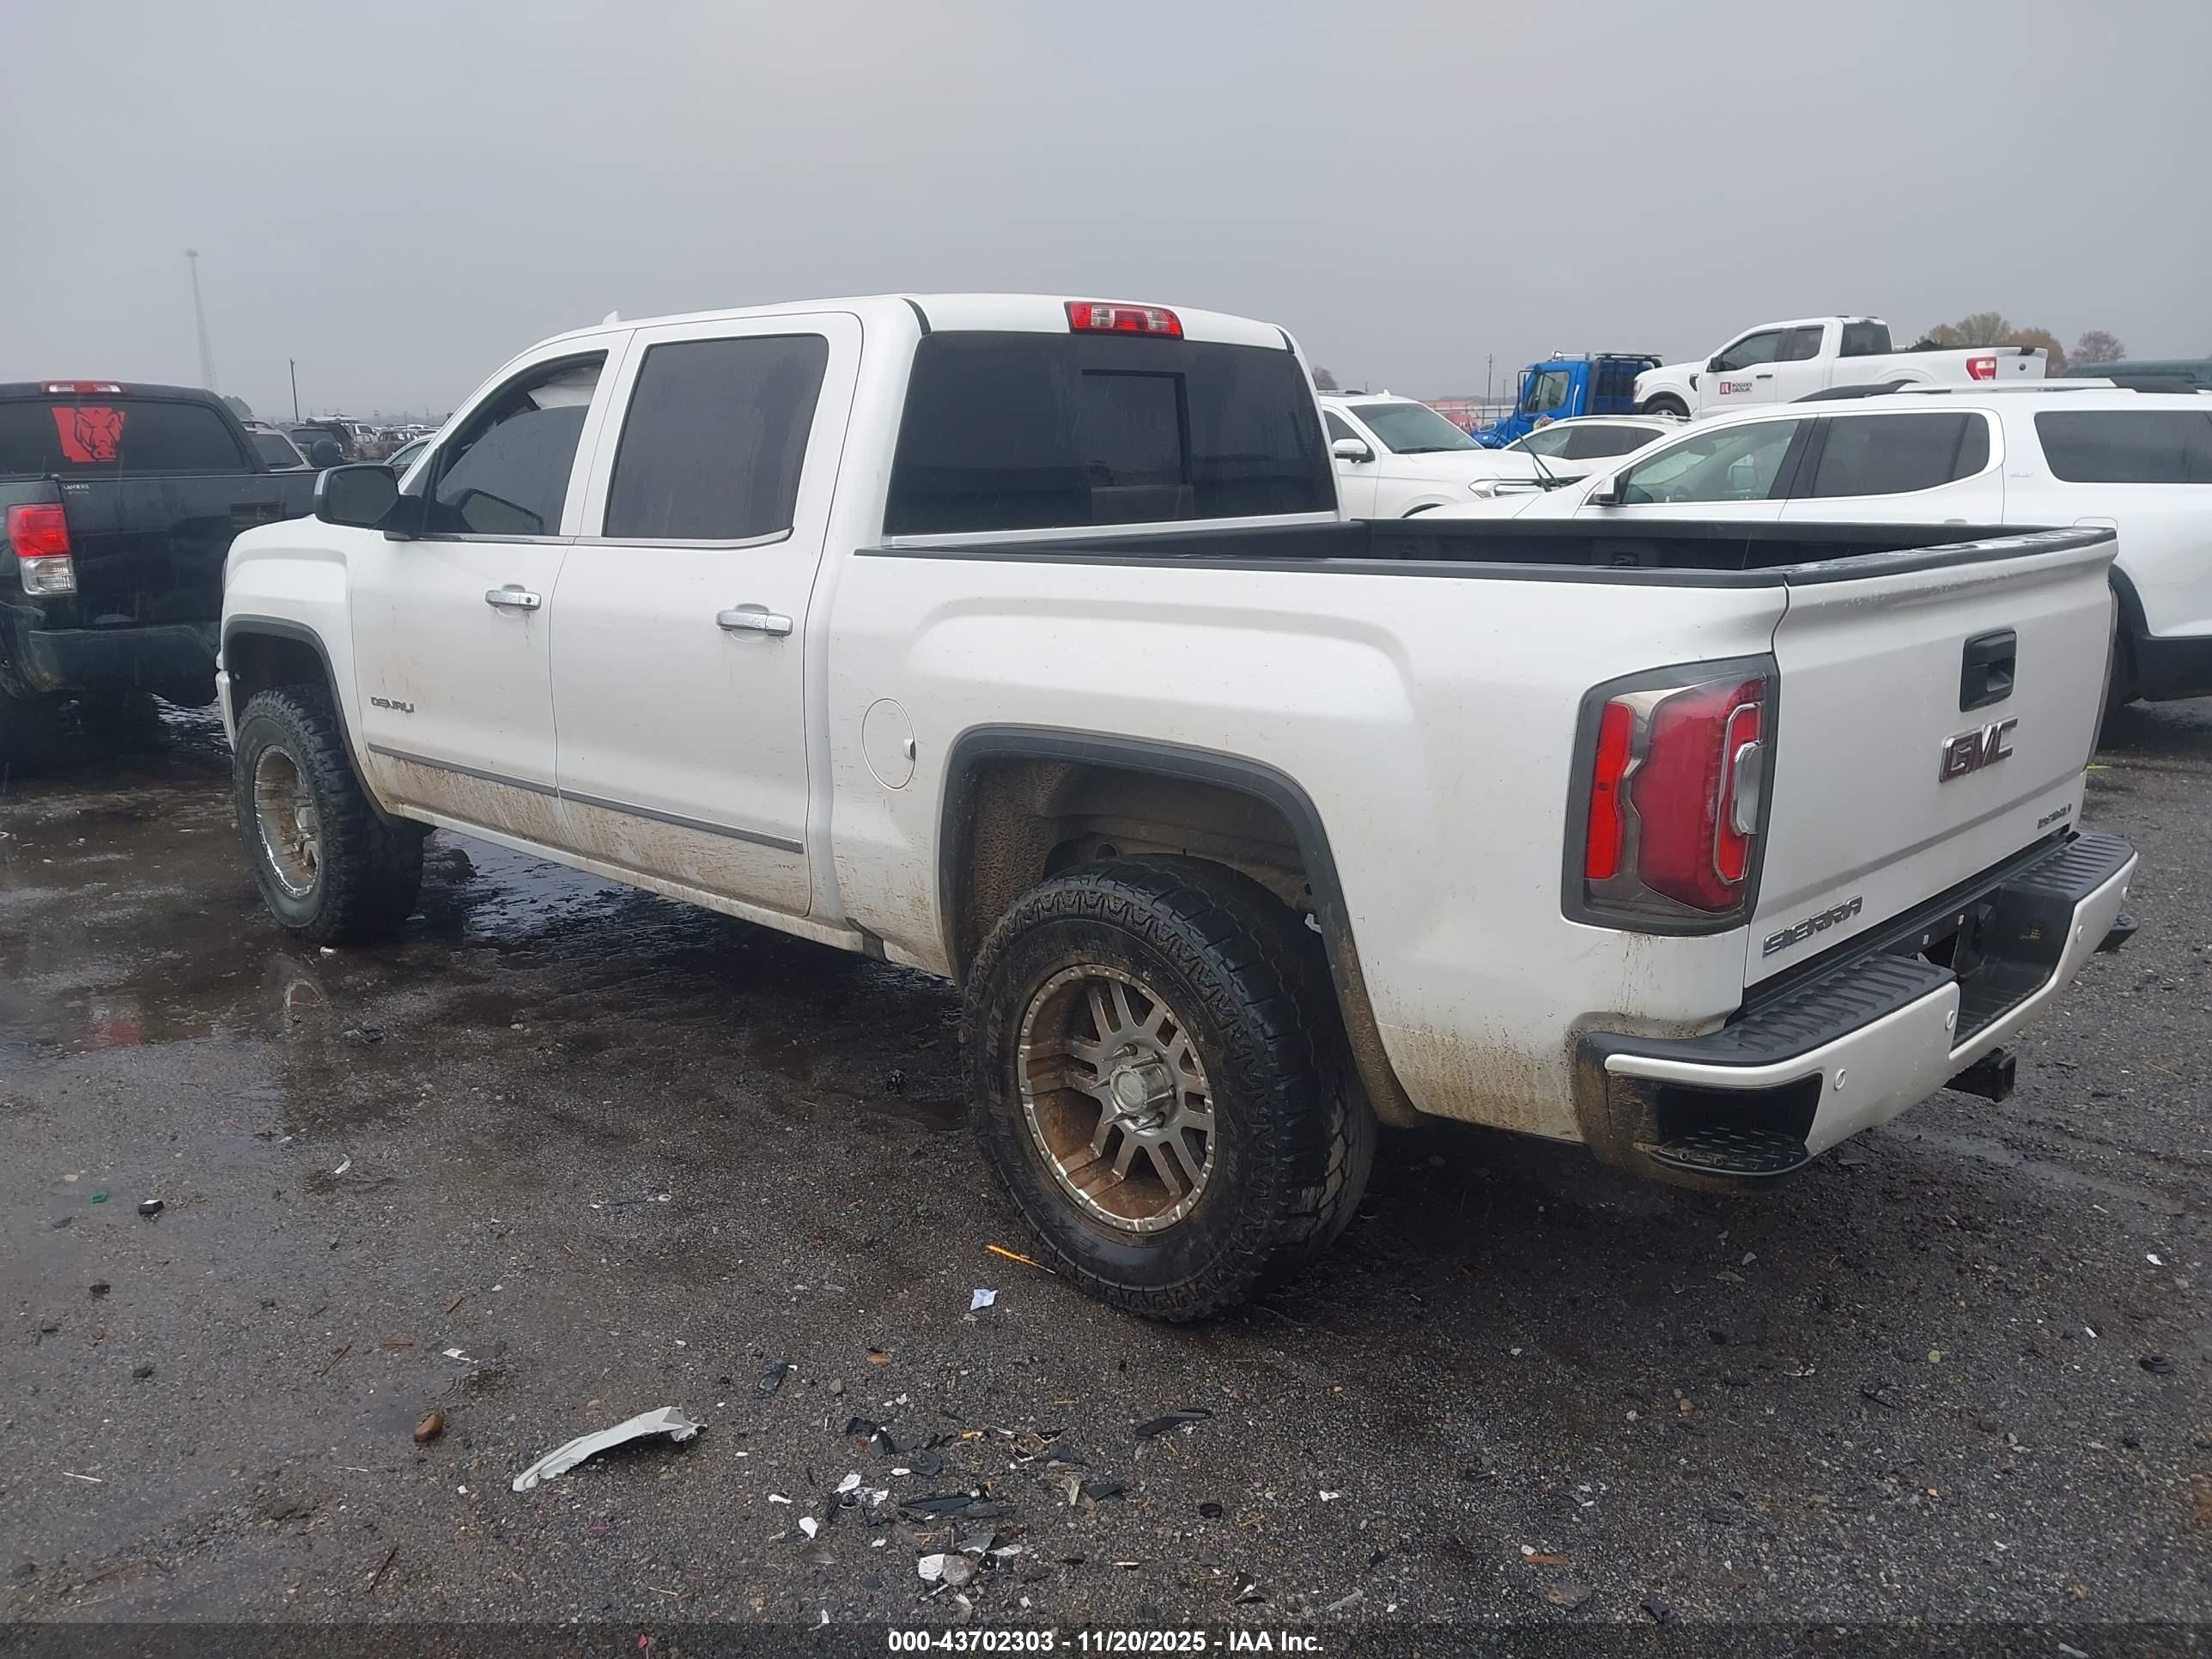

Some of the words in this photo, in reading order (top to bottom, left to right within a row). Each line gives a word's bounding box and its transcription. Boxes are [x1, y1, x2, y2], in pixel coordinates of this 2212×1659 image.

[370, 696, 415, 714] DENALI
[1939, 714, 2019, 783] GMC
[1763, 894, 1863, 958] SIERRA
